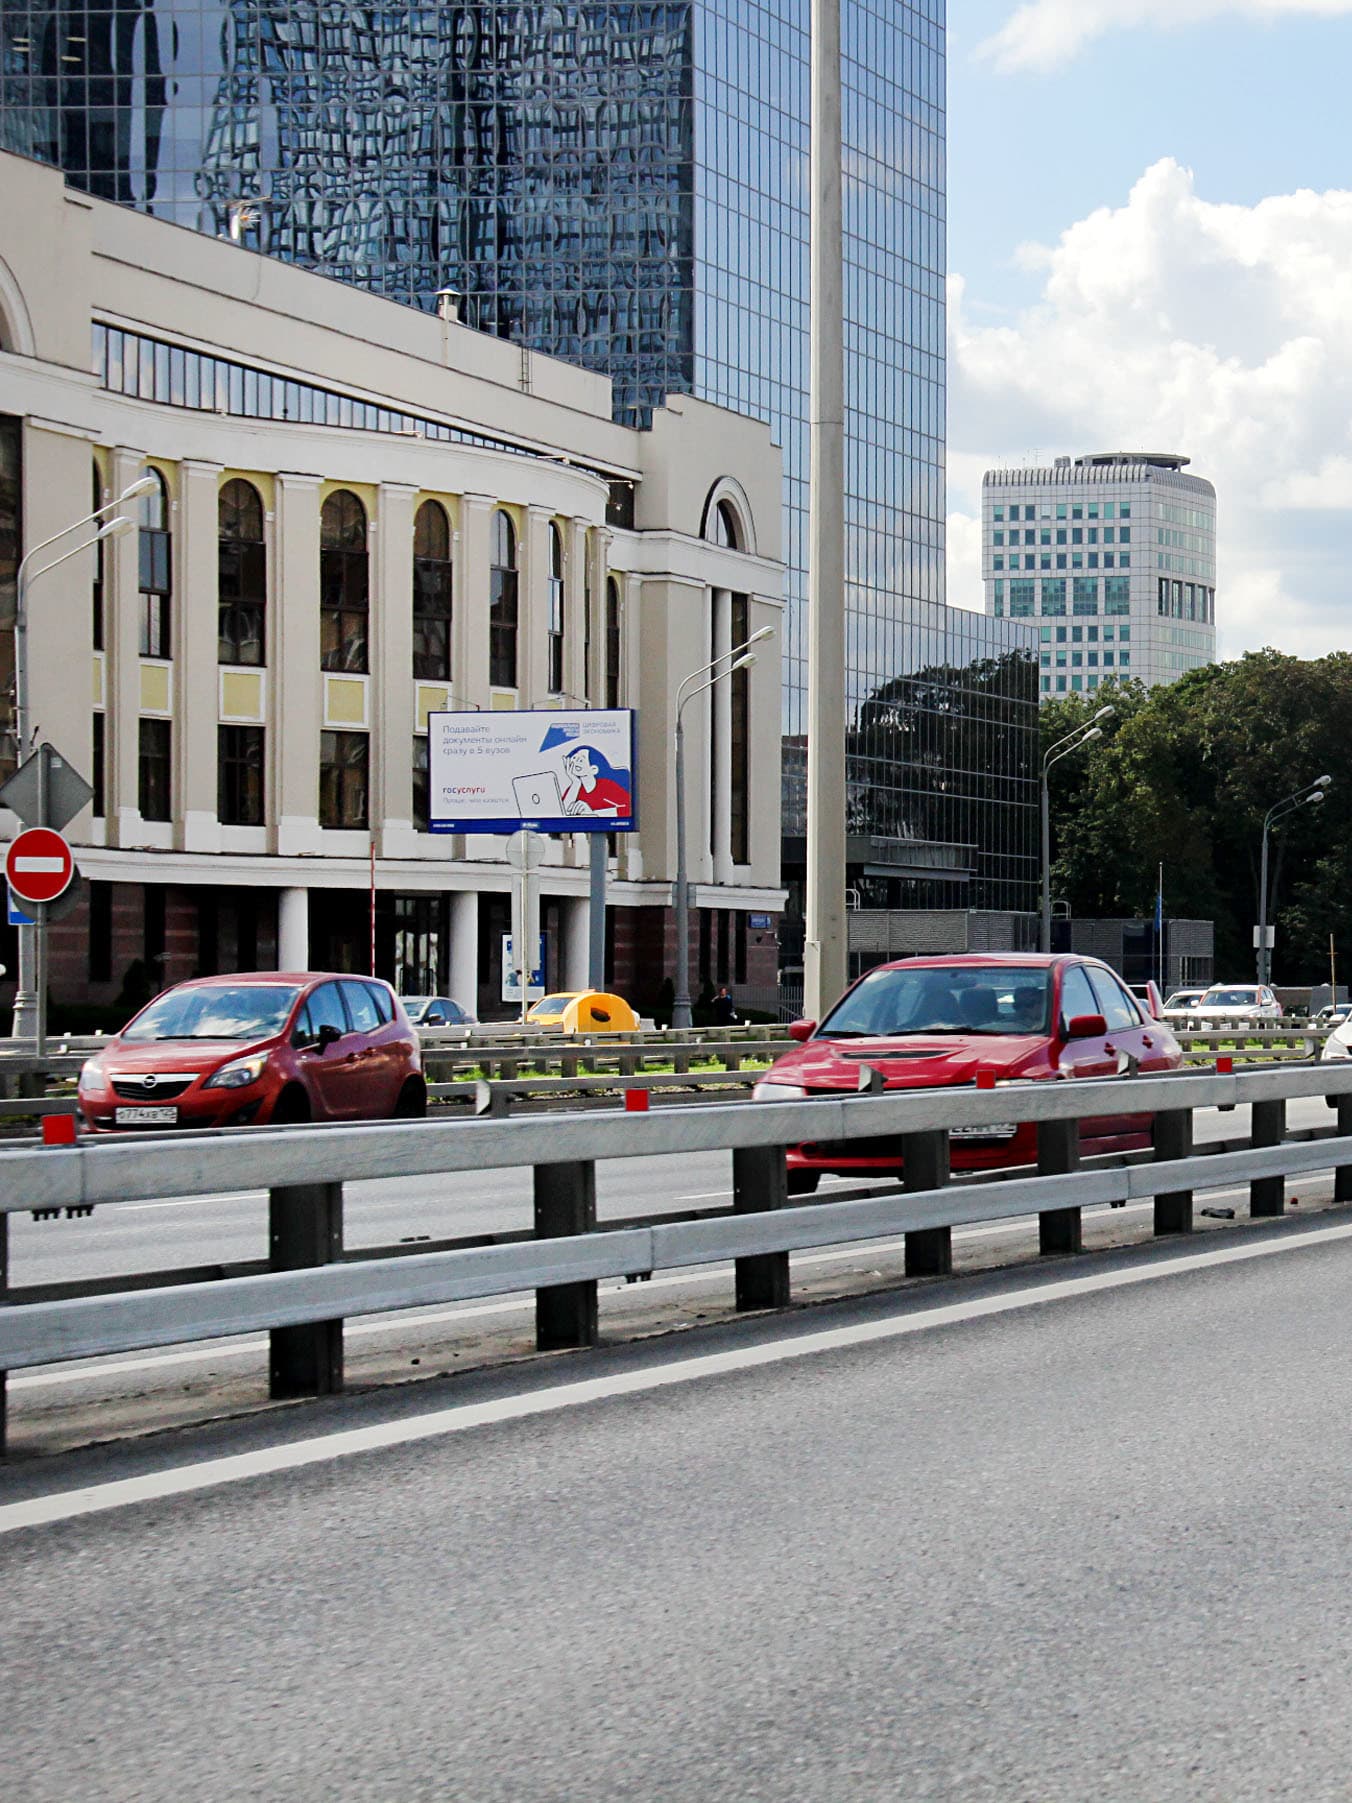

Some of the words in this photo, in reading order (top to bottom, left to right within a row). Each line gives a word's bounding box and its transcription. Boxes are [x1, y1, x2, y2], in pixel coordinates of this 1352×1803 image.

[442, 725, 490, 735] Подавайте
[442, 737, 493, 746] документы
[494, 735, 528, 744] онлайн
[442, 747, 468, 756] сразу
[485, 747, 511, 756] вузов
[442, 787, 486, 795] госуслуги
